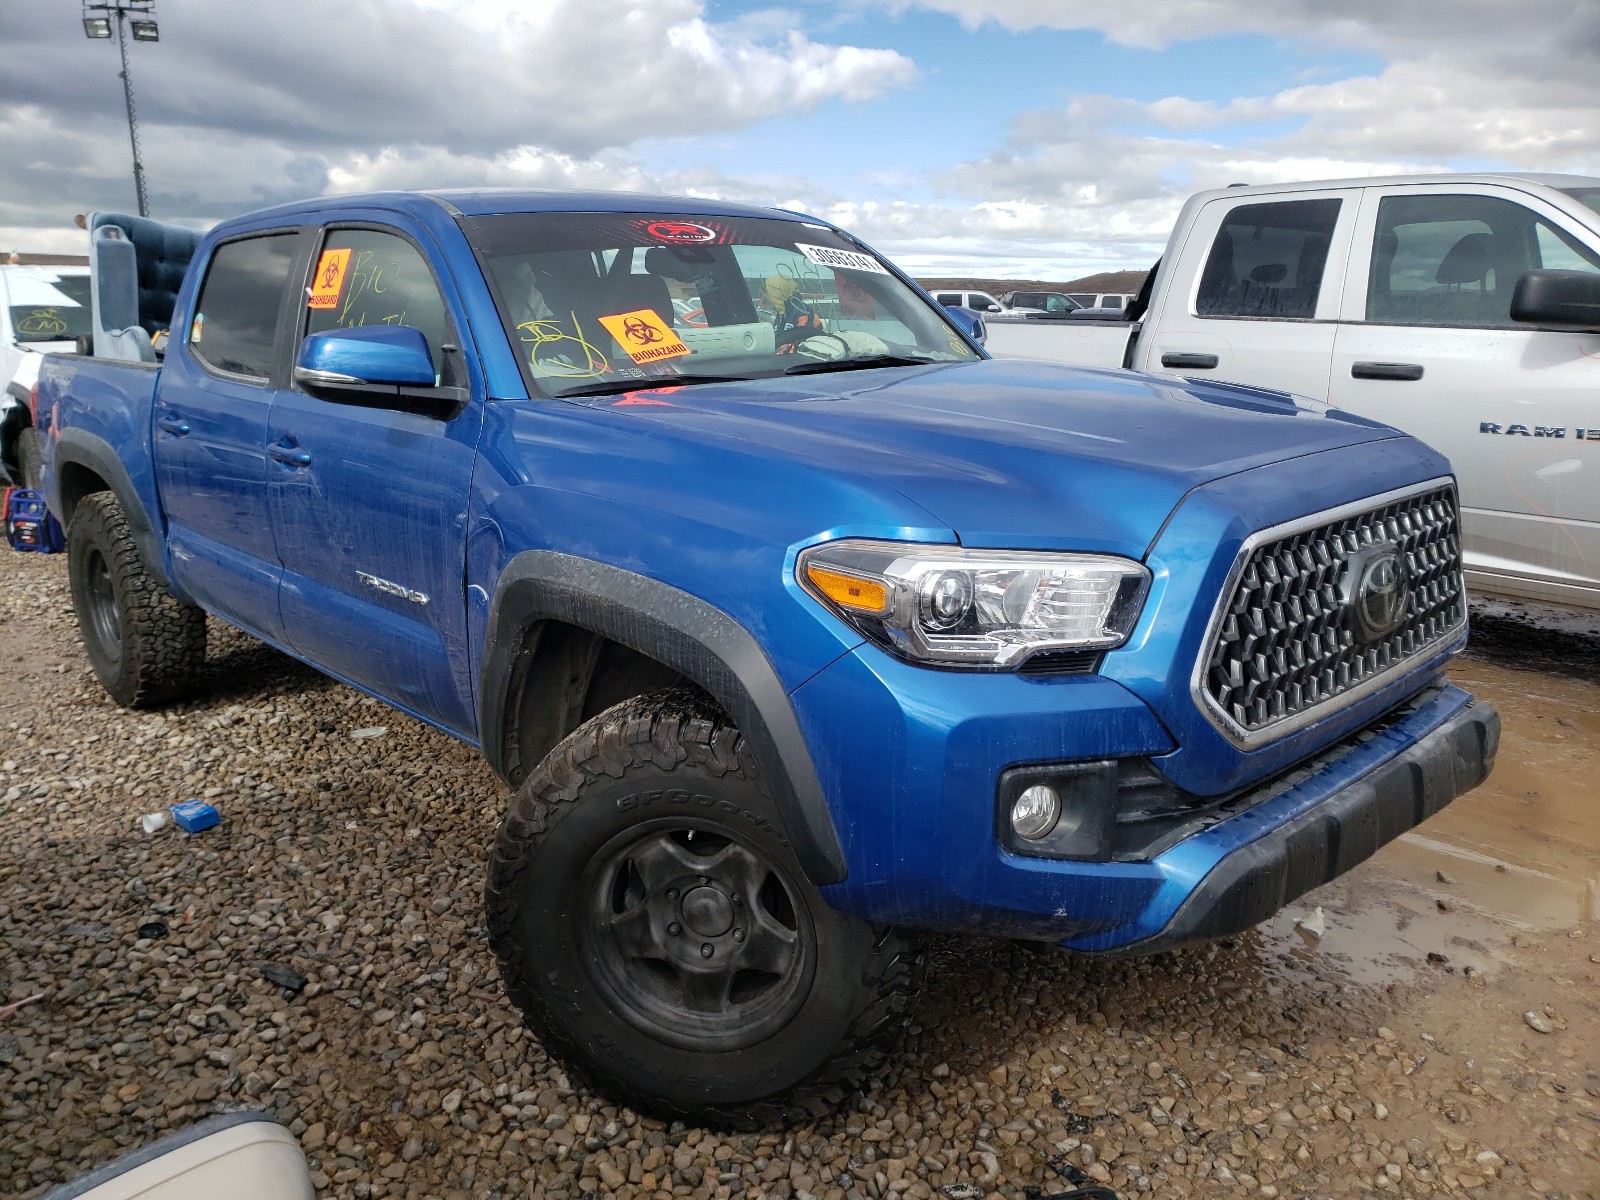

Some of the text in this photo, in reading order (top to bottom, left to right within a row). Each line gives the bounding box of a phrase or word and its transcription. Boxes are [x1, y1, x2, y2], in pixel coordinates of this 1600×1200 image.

[808, 246, 877, 271] 30663141
[632, 343, 687, 362] BIOHAZARD
[1479, 421, 1567, 438] RAM
[355, 570, 429, 605] TACOMA
